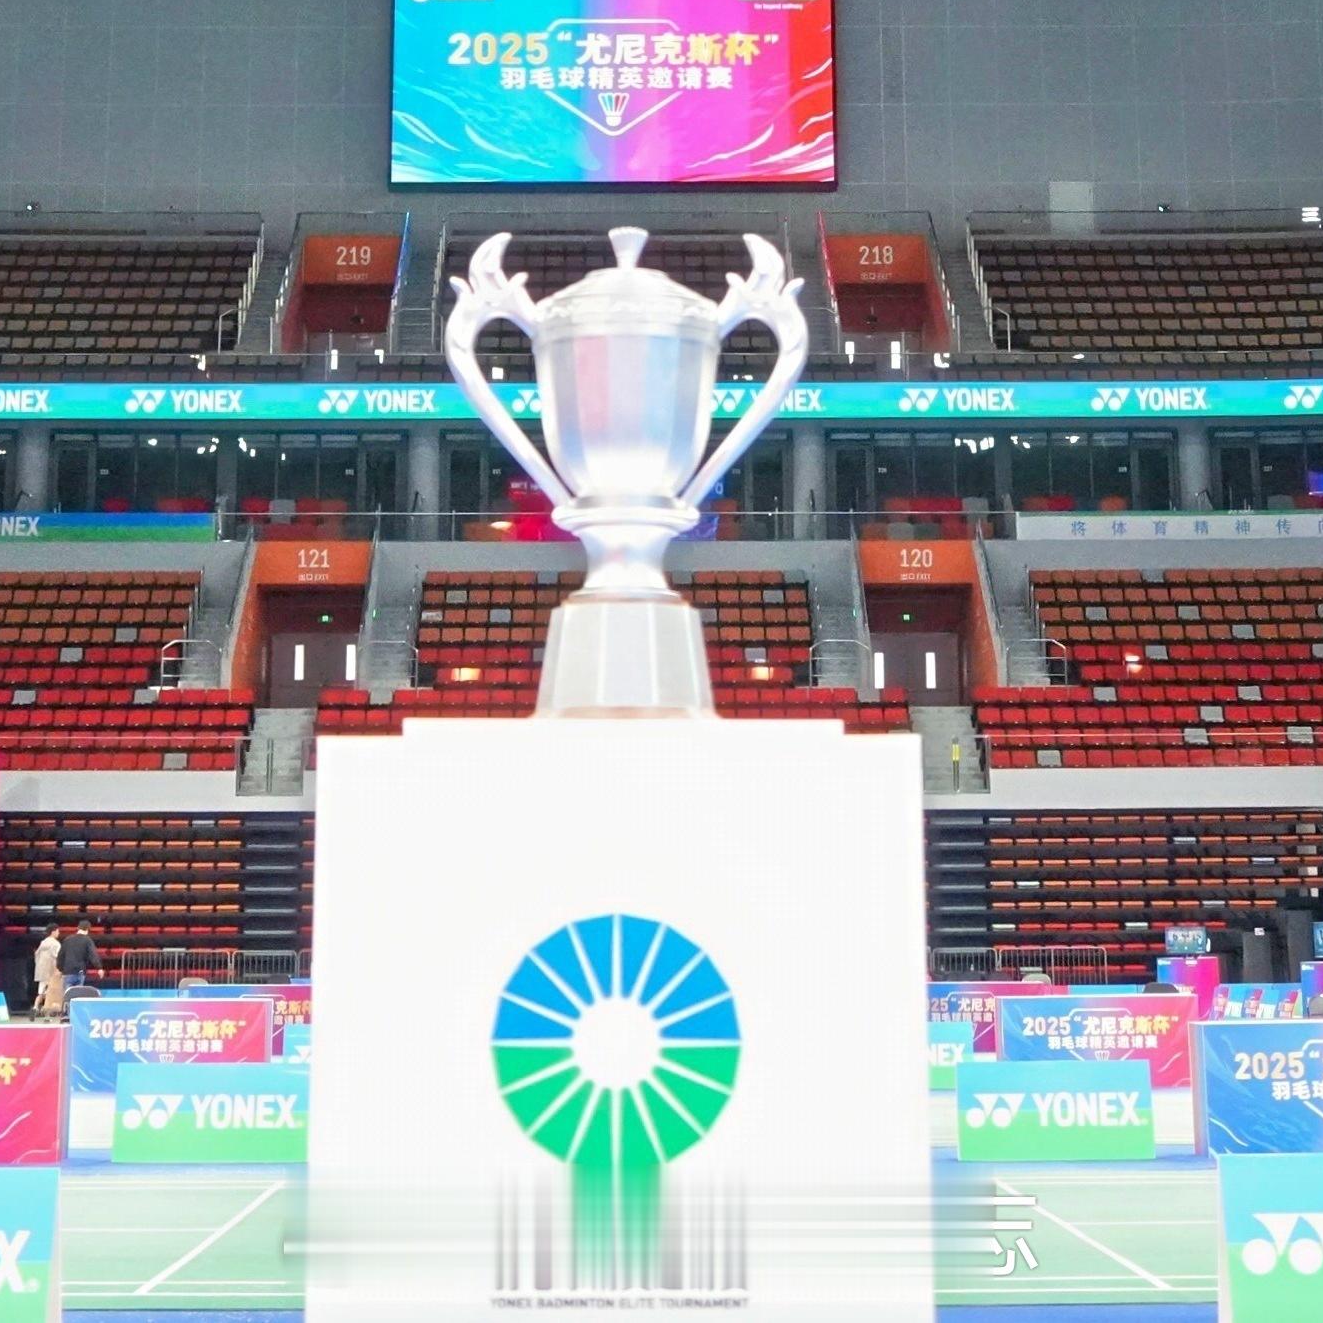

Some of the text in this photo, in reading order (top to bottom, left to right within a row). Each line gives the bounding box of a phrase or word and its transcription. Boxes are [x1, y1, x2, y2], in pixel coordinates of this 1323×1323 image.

[500, 66, 733, 90] 羽毛球精英邀请赛
[336, 246, 371, 265] 219
[859, 245, 893, 265] 218
[171, 389, 243, 413] YONEX
[364, 389, 436, 413] YONEX
[750, 389, 822, 412] NEX
[944, 388, 1015, 412] YONEX
[1136, 387, 1208, 411] YONEX
[298, 549, 330, 568] 121
[900, 548, 933, 568] 120
[928, 1043, 966, 1063] NEX
[190, 1093, 298, 1129] YONEX
[1033, 1091, 1141, 1128] YONEX
[537, 1297, 615, 1309] BADMINTON
[619, 1297, 655, 1309] ELITE
[659, 1297, 749, 1309] TOURNAMENT
